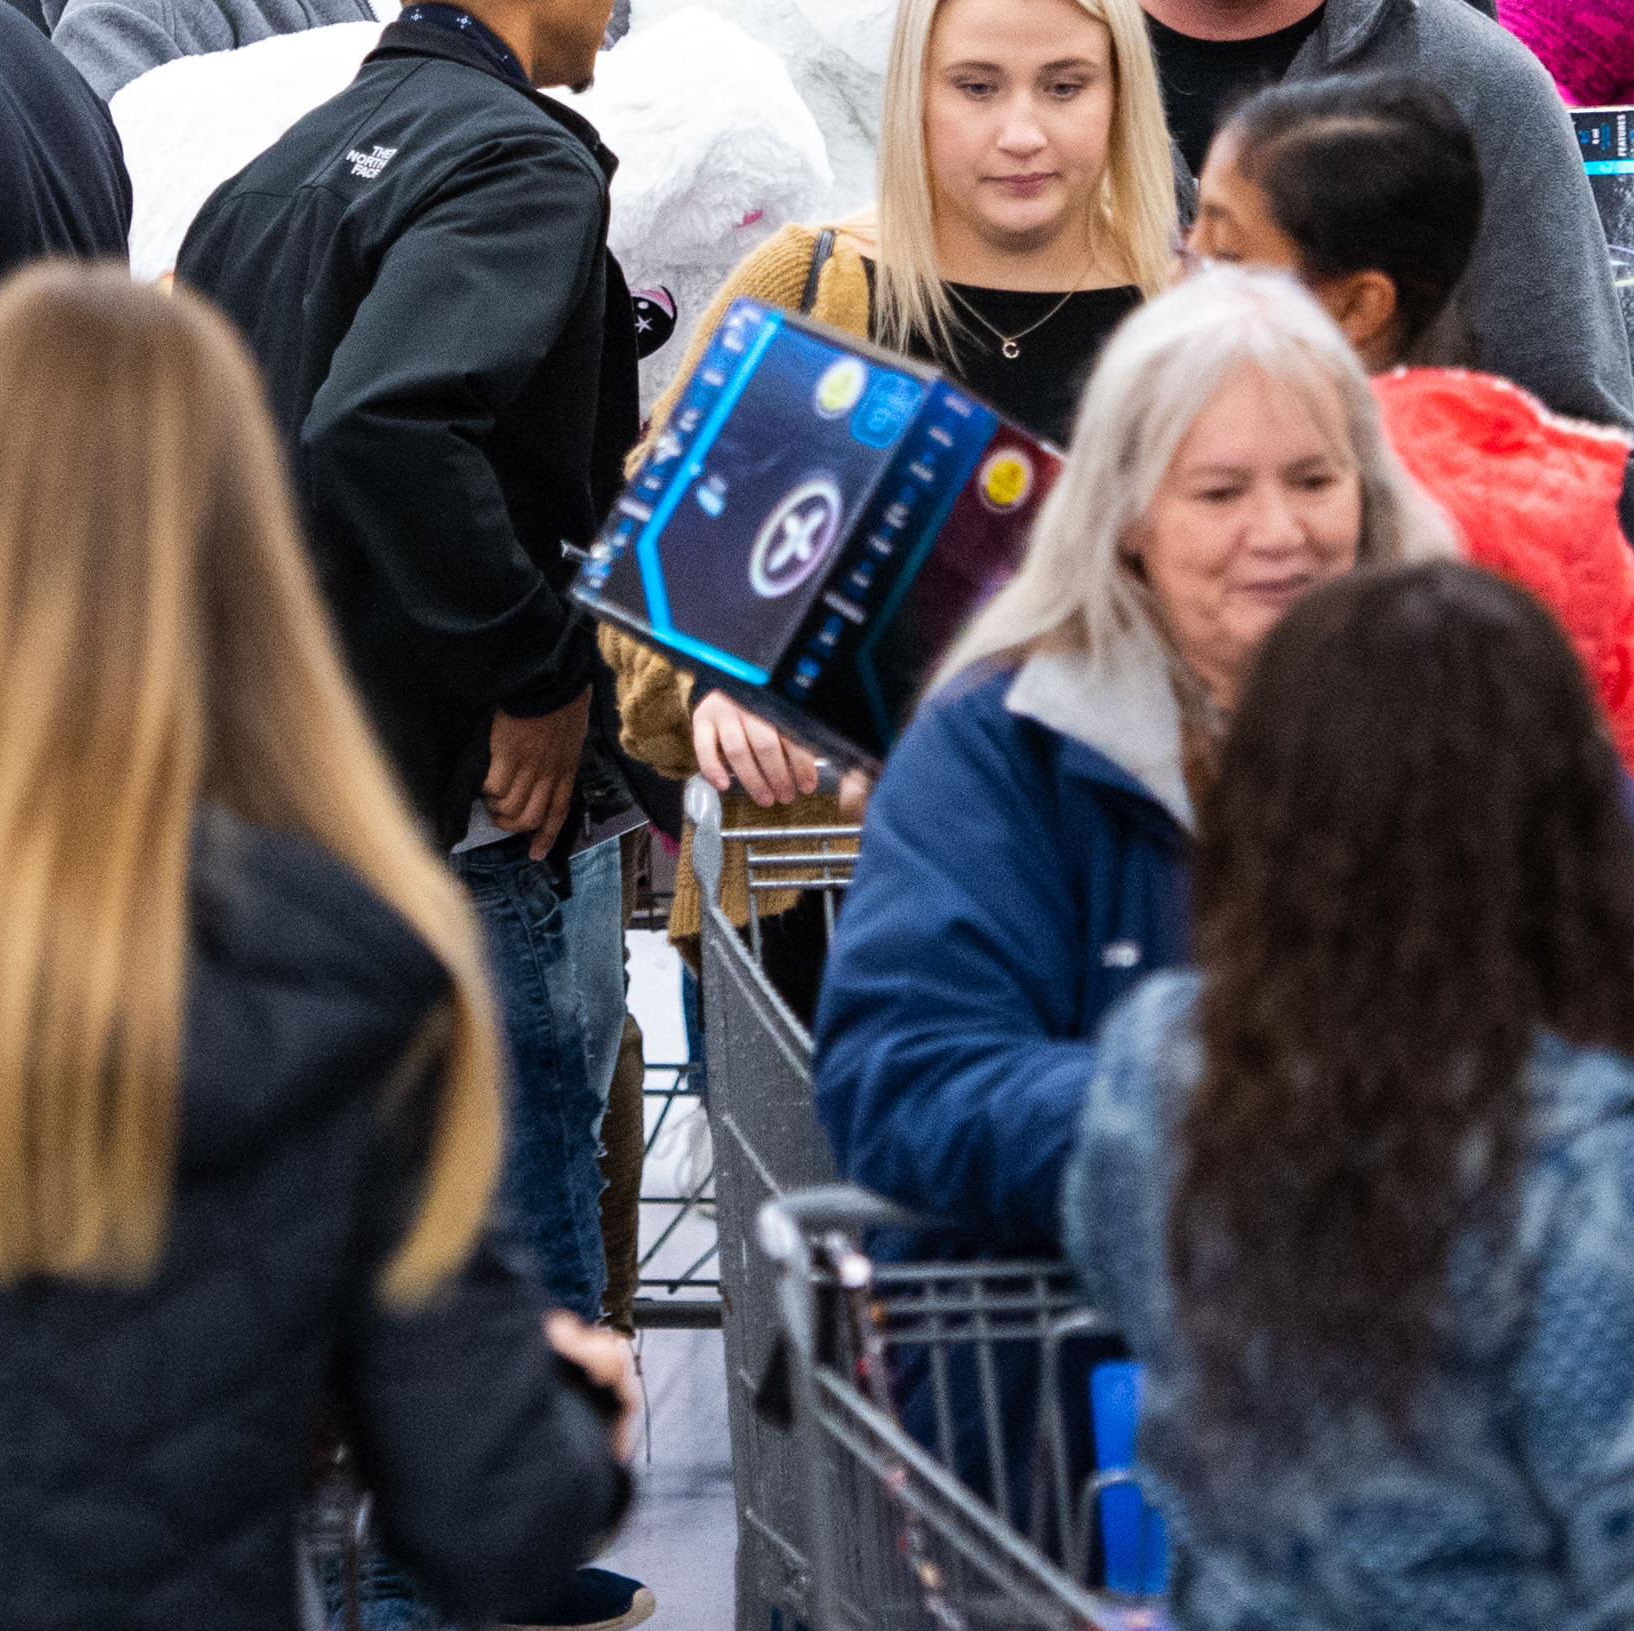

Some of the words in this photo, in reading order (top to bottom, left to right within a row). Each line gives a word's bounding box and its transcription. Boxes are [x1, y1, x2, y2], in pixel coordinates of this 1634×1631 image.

[1617, 114, 1627, 156] FEATURES
[346, 150, 389, 169] NORTH
[372, 146, 398, 160] THE
[350, 164, 381, 179] FACE
